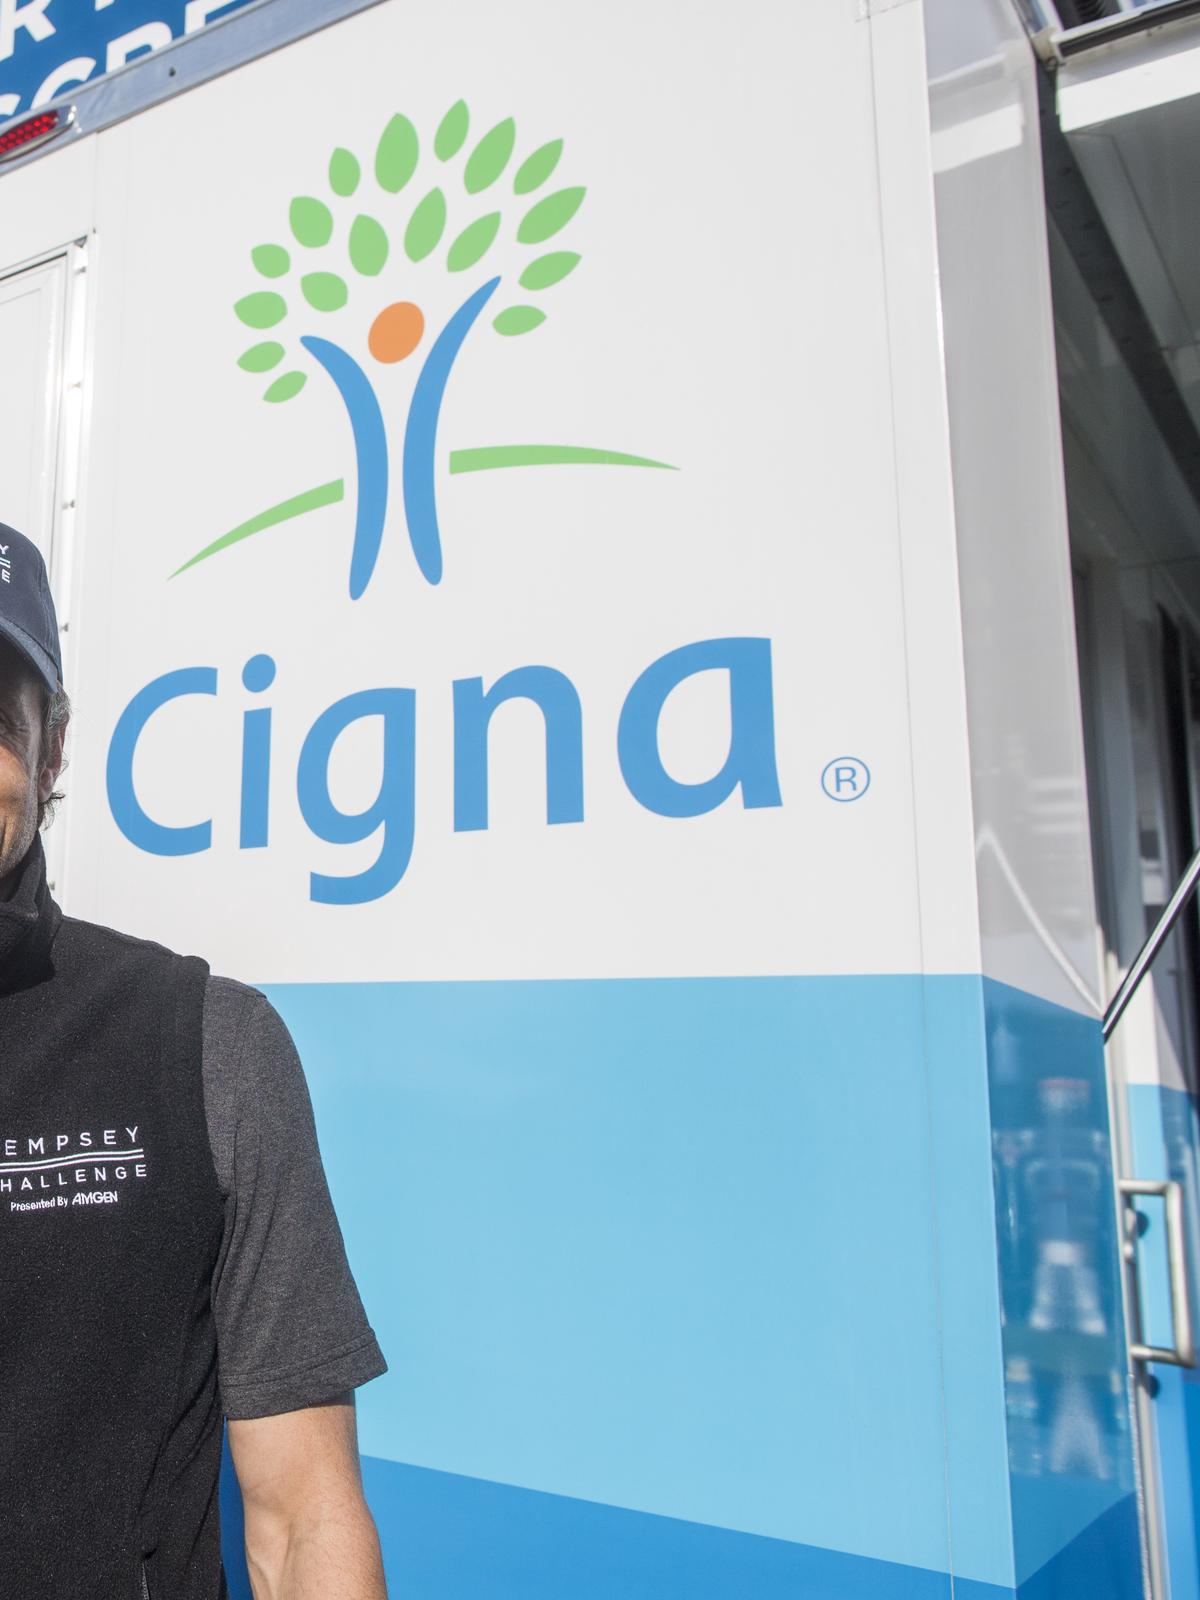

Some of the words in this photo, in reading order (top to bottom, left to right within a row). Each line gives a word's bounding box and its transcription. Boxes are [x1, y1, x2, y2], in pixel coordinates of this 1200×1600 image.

[105, 636, 784, 906] Cigna
[10, 1197, 55, 1211] Presented
[57, 1196, 68, 1207] By
[72, 1191, 118, 1205] AMGEN
